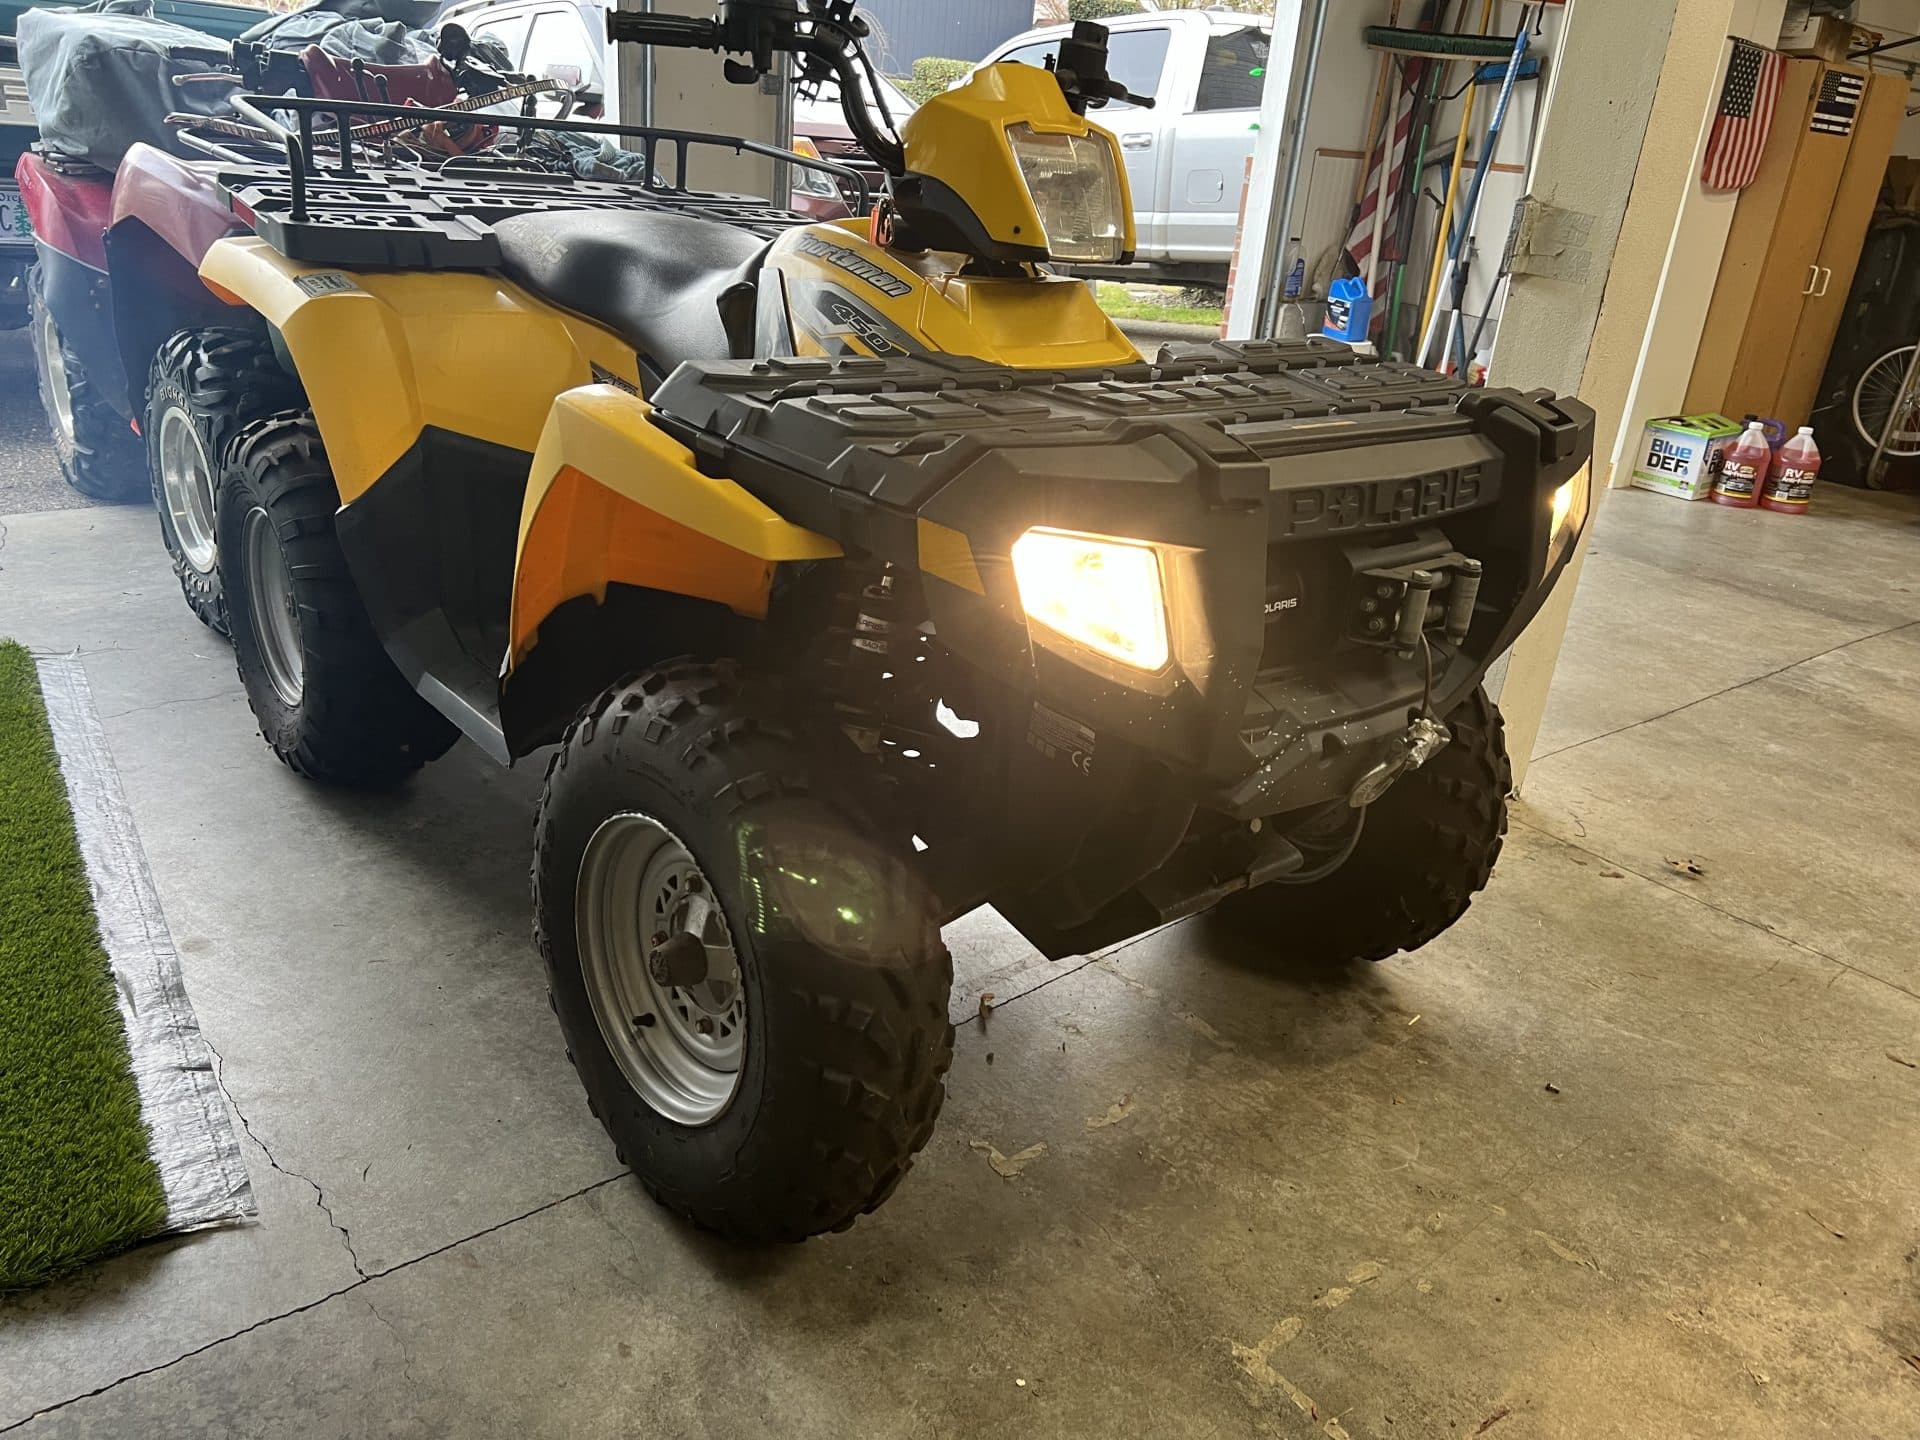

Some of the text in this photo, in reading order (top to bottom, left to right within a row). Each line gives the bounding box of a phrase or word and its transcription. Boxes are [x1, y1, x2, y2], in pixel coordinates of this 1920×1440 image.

[799, 232, 912, 297] portsman
[831, 303, 892, 352] 450
[1651, 438, 1692, 459] Blue
[1646, 452, 1689, 473] DEF
[1725, 460, 1741, 471] RV
[1785, 468, 1804, 478] RV
[1282, 464, 1482, 537] POLARIS
[1264, 598, 1297, 614] OLARIS
